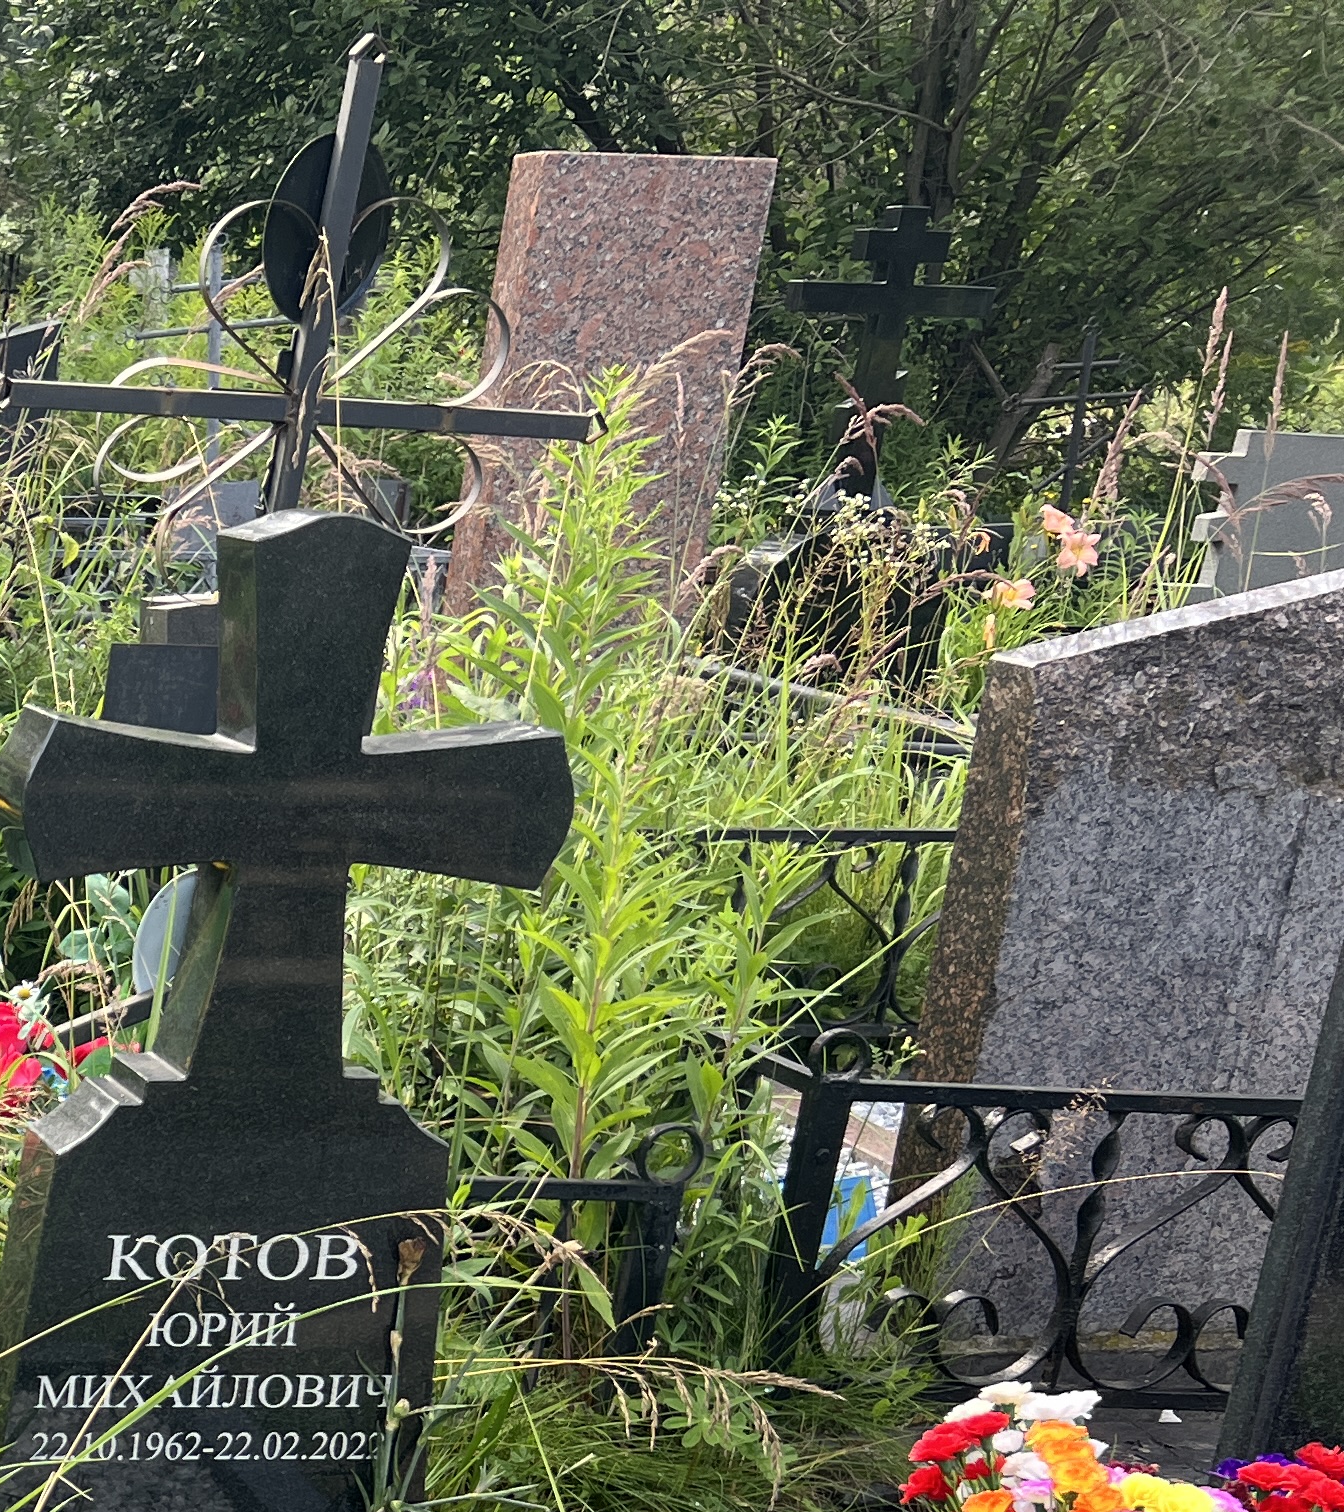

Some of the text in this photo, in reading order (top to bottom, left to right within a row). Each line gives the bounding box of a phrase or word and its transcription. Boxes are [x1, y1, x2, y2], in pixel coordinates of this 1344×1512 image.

[103, 1233, 359, 1281] КОТОВ
[145, 1301, 301, 1348] ЮРИЙ
[34, 1363, 392, 1409] МИХАЙЛОВИЧ
